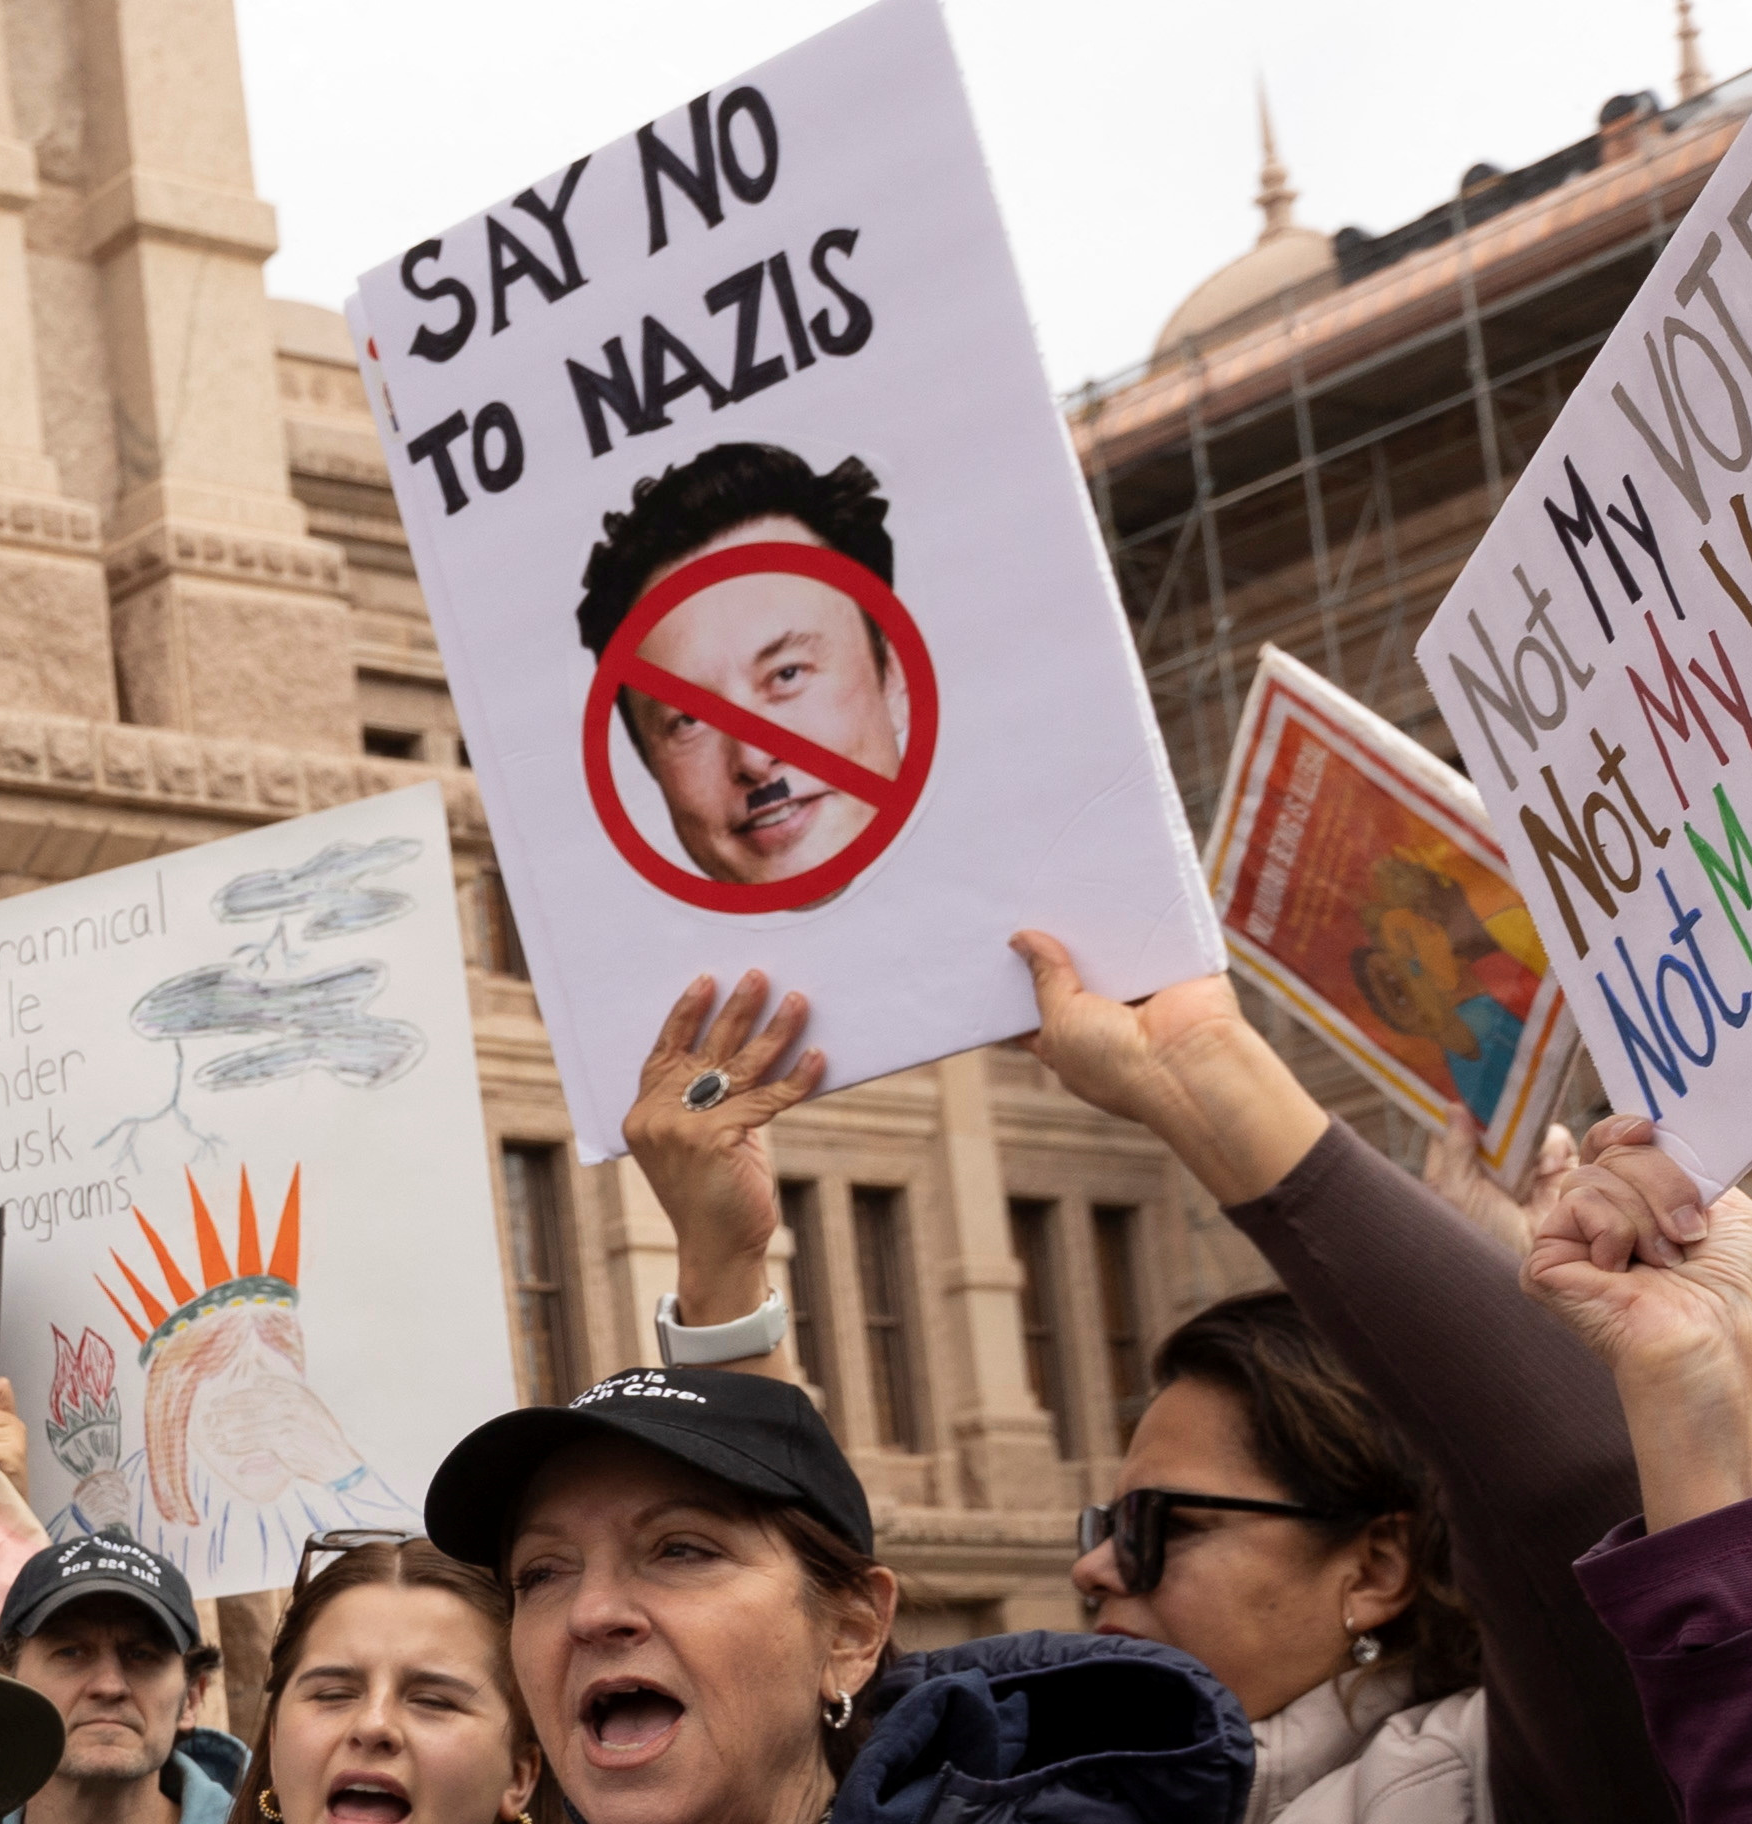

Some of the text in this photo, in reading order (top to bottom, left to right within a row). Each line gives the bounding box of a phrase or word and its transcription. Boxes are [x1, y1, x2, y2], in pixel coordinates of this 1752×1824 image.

[400, 84, 779, 363] SAY NO
[408, 229, 873, 516] TO NAZIS
[1448, 184, 1752, 791] Not My VOT
[1519, 727, 1671, 960] Not
[1597, 867, 1752, 1122] Not
[622, 1383, 706, 1404] Care.
[644, 1371, 666, 1384] is
[58, 1536, 162, 1575] CALL CONGRESS
[62, 1561, 91, 1577] 202
[98, 1558, 127, 1571] 224
